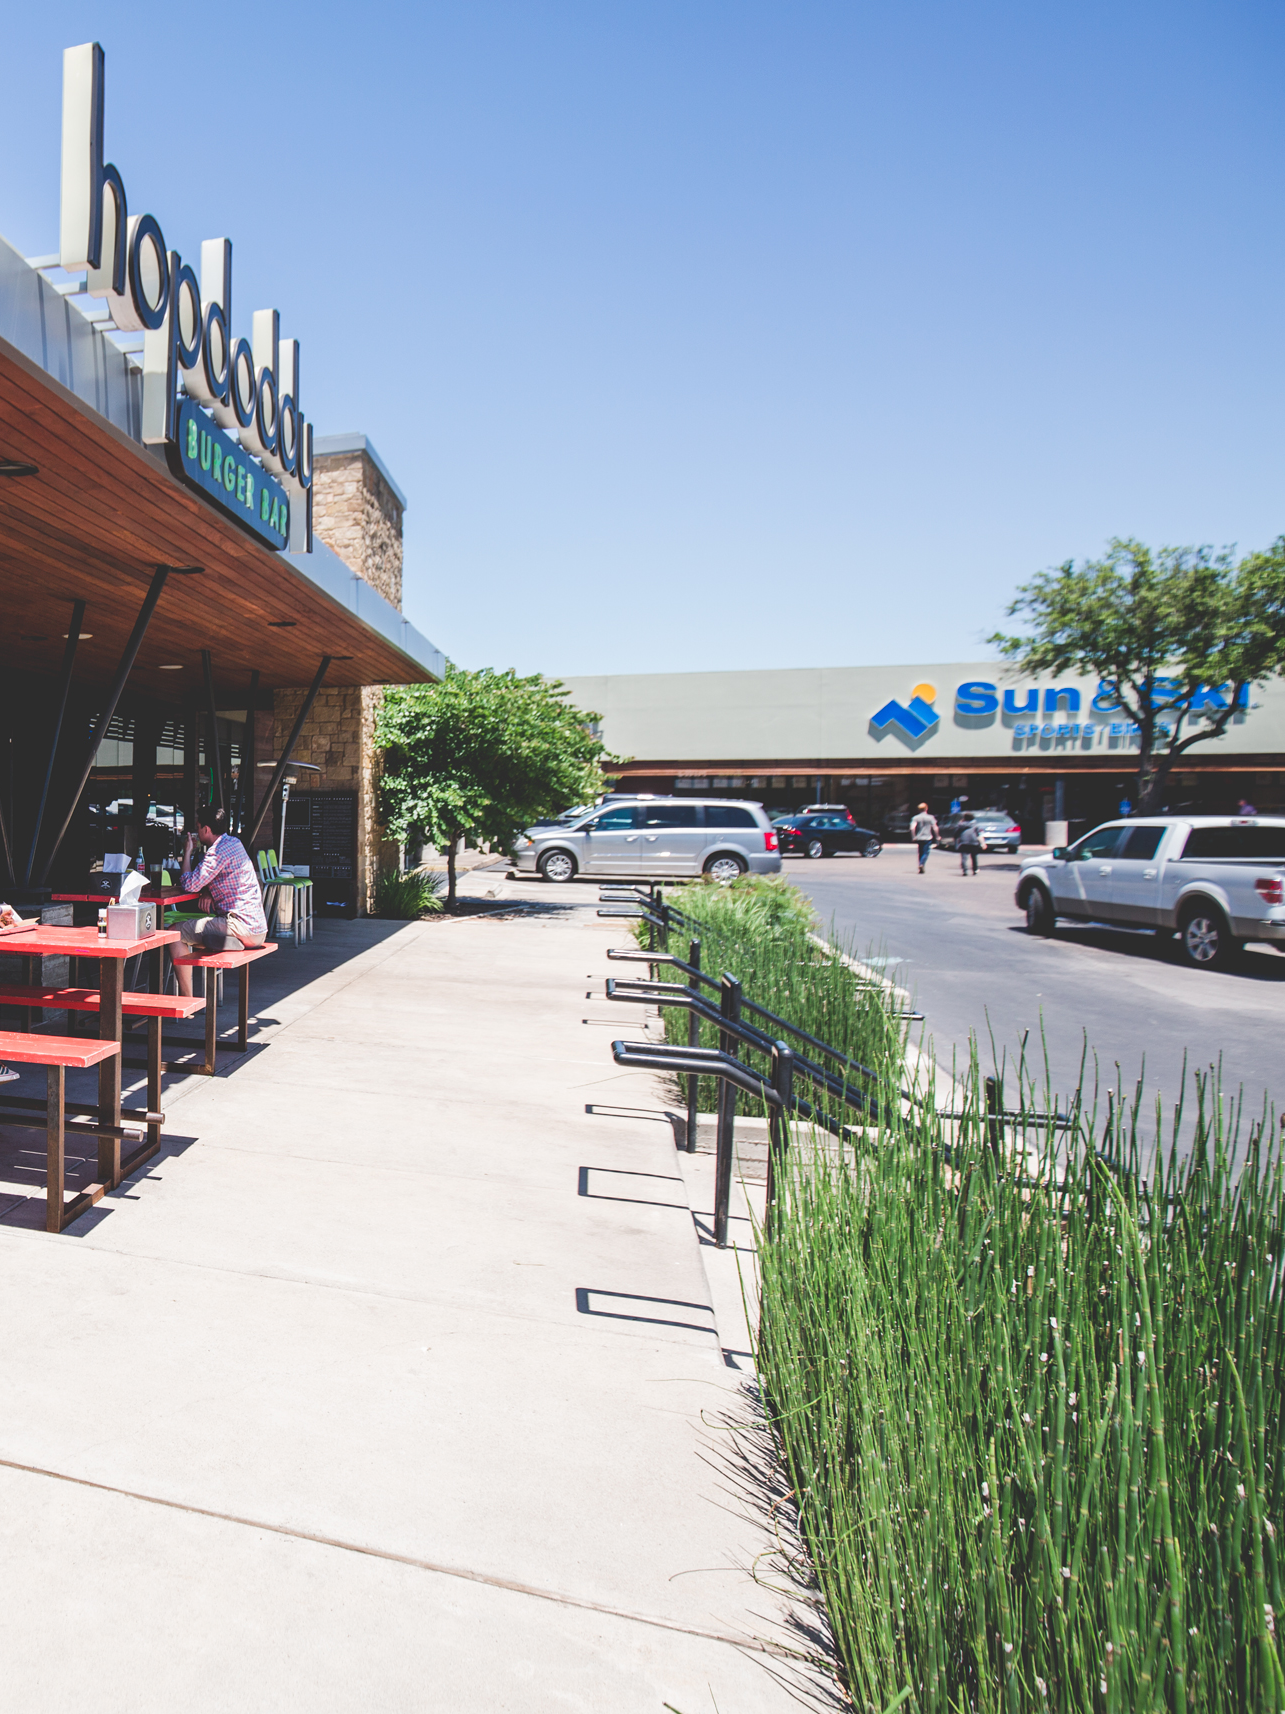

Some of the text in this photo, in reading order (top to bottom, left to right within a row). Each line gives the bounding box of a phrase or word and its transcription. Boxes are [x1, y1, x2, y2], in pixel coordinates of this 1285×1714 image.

[187, 418, 287, 537] BURGER BAR
[956, 681, 1082, 716] Sun
[1013, 723, 1097, 738] SPORTS
